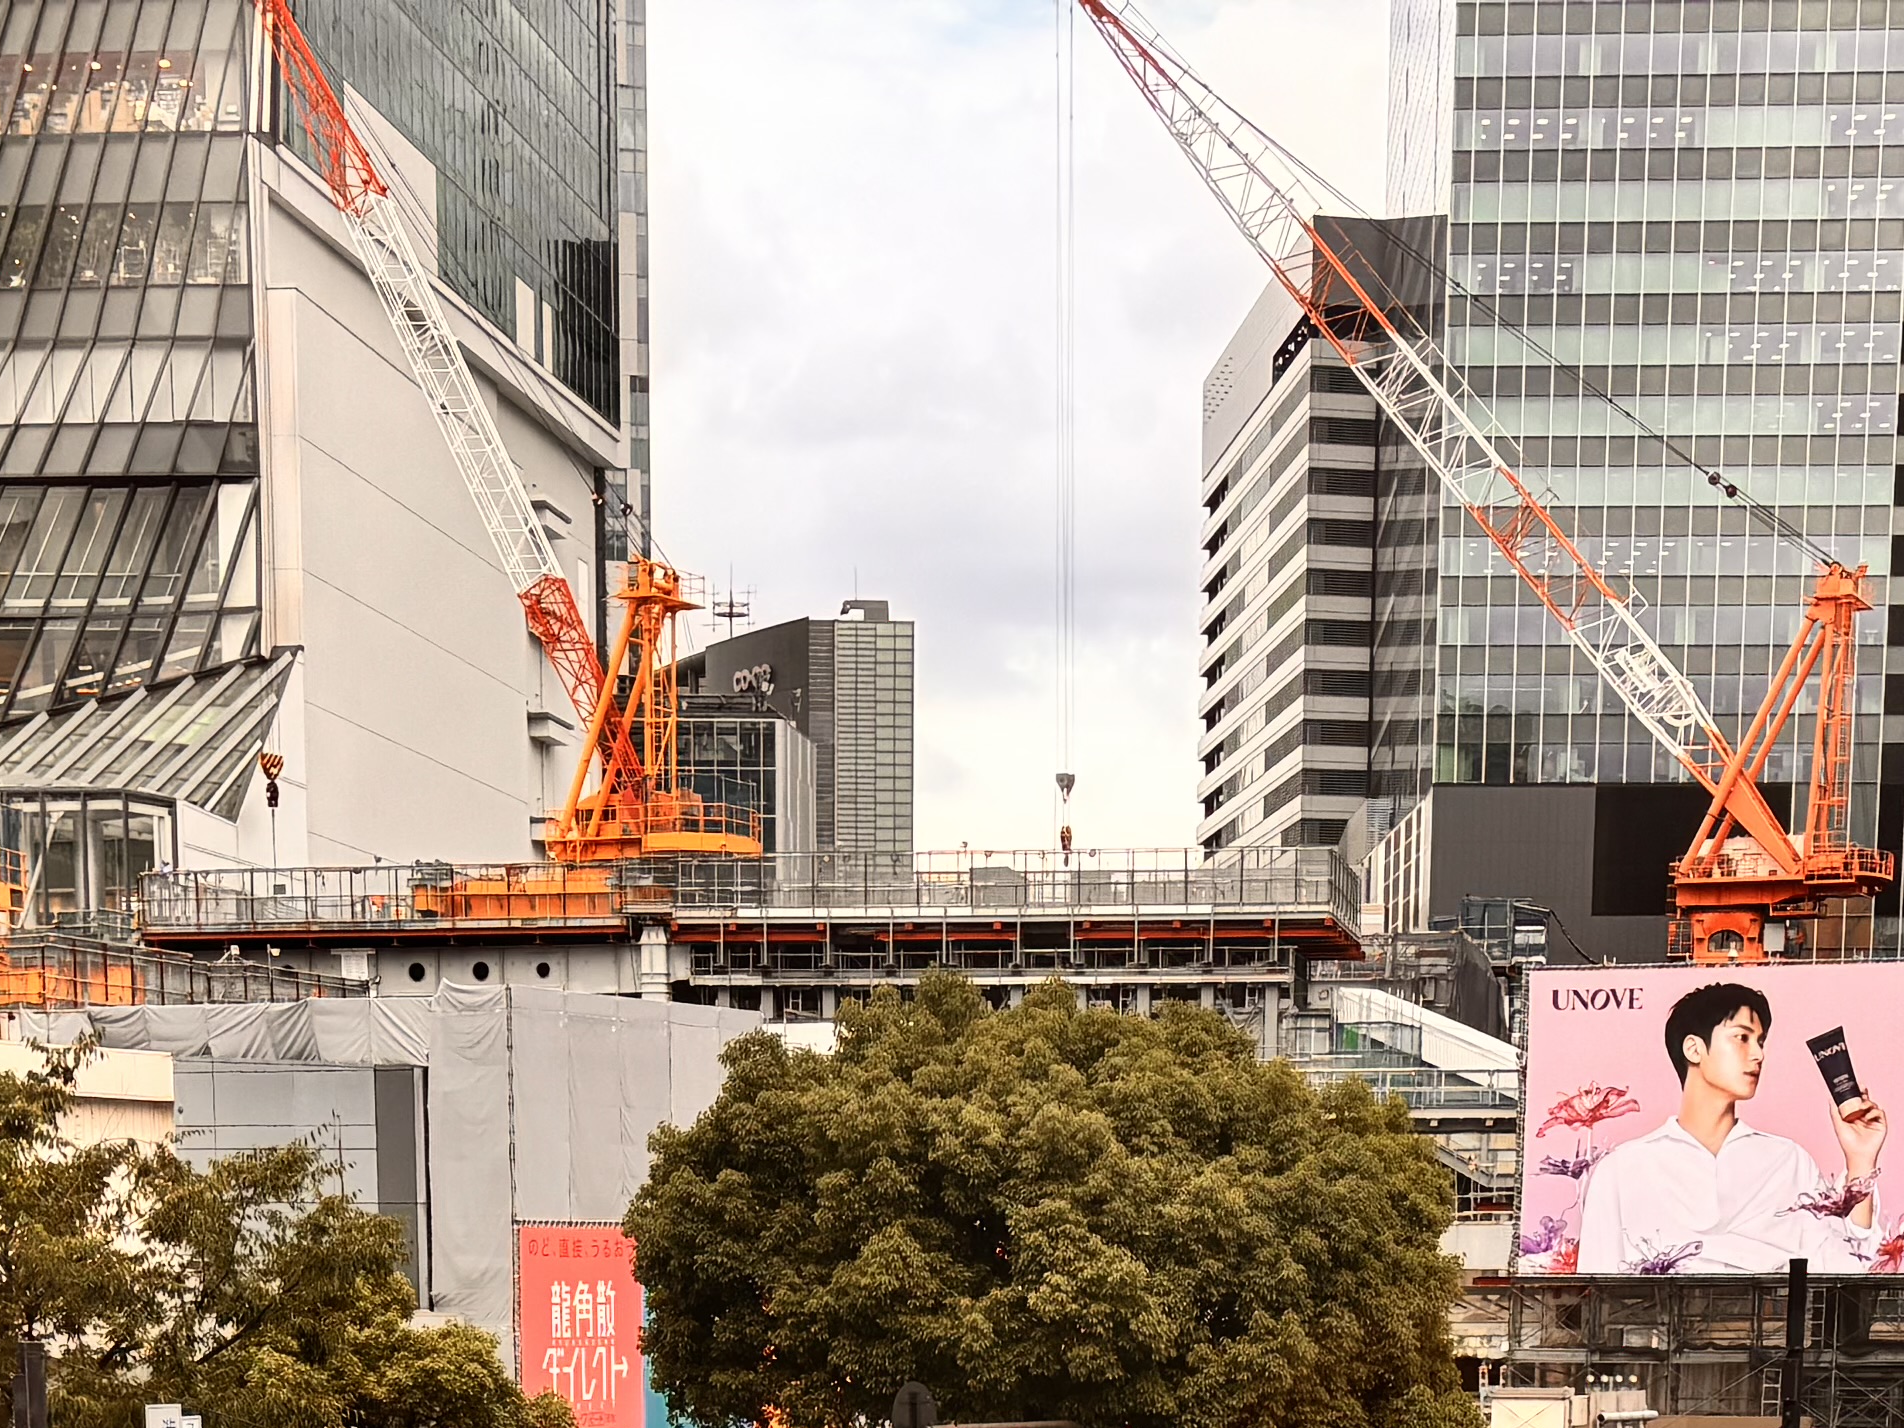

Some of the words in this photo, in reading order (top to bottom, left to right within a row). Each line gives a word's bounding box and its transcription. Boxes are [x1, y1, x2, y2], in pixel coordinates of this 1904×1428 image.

[1551, 987, 1644, 1011] UNOVE
[551, 1280, 616, 1338] 龍角散
[543, 1346, 628, 1402] ダイレクト
